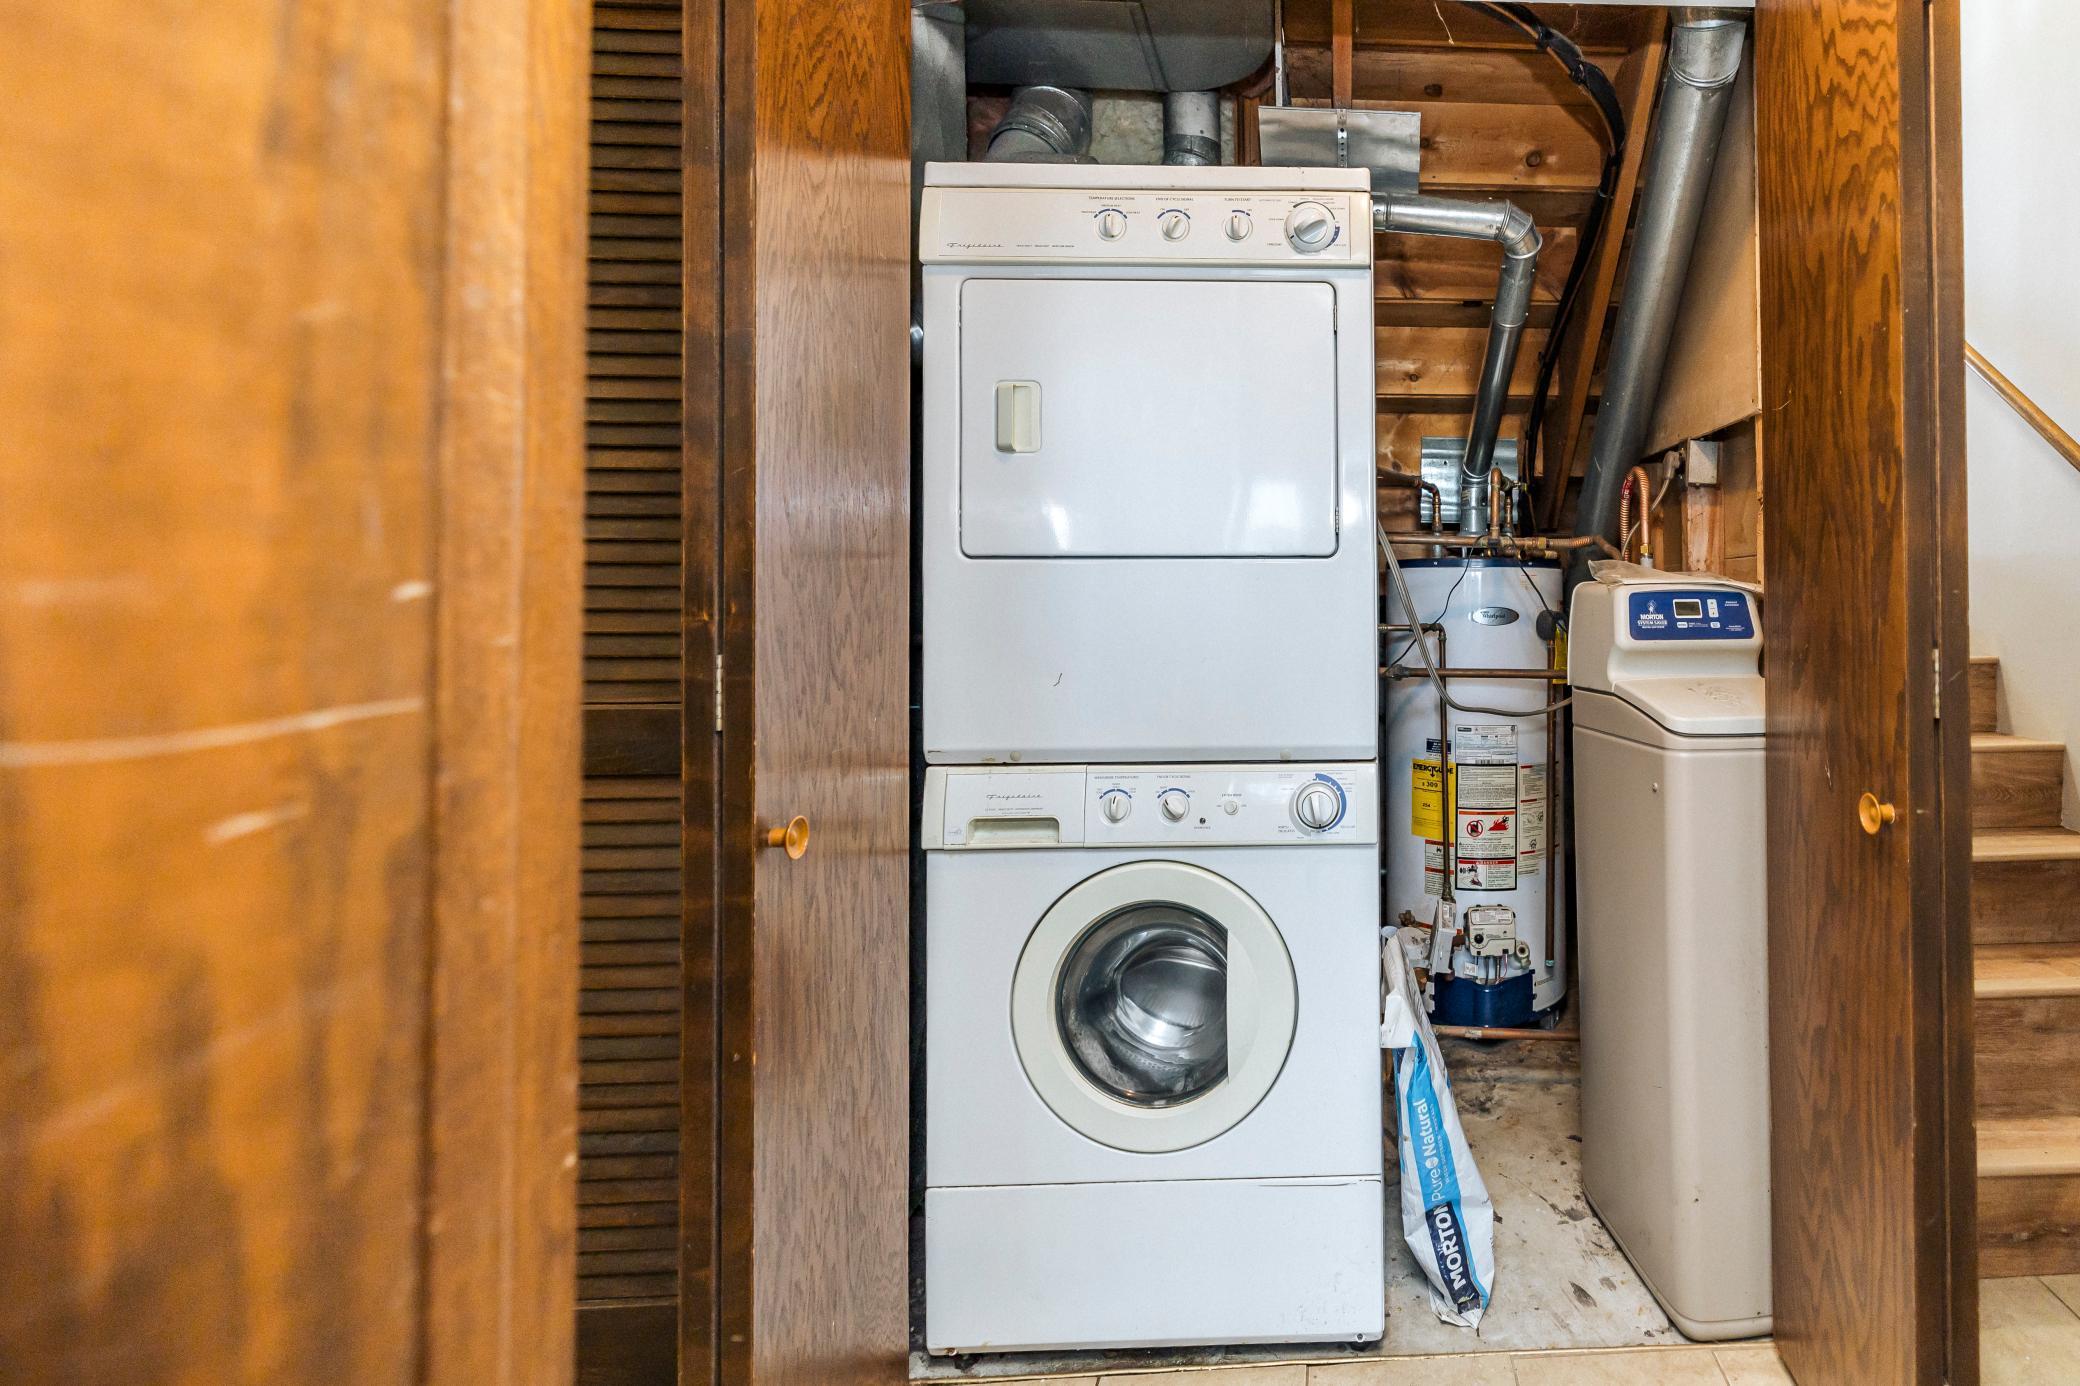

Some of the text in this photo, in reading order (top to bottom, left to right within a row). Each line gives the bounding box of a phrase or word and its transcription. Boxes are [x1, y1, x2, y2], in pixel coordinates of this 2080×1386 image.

[946, 242, 1006, 250] Frigidaire
[986, 793, 1044, 801] Frigidaire
[1413, 1097, 1445, 1202] Pure Natural
